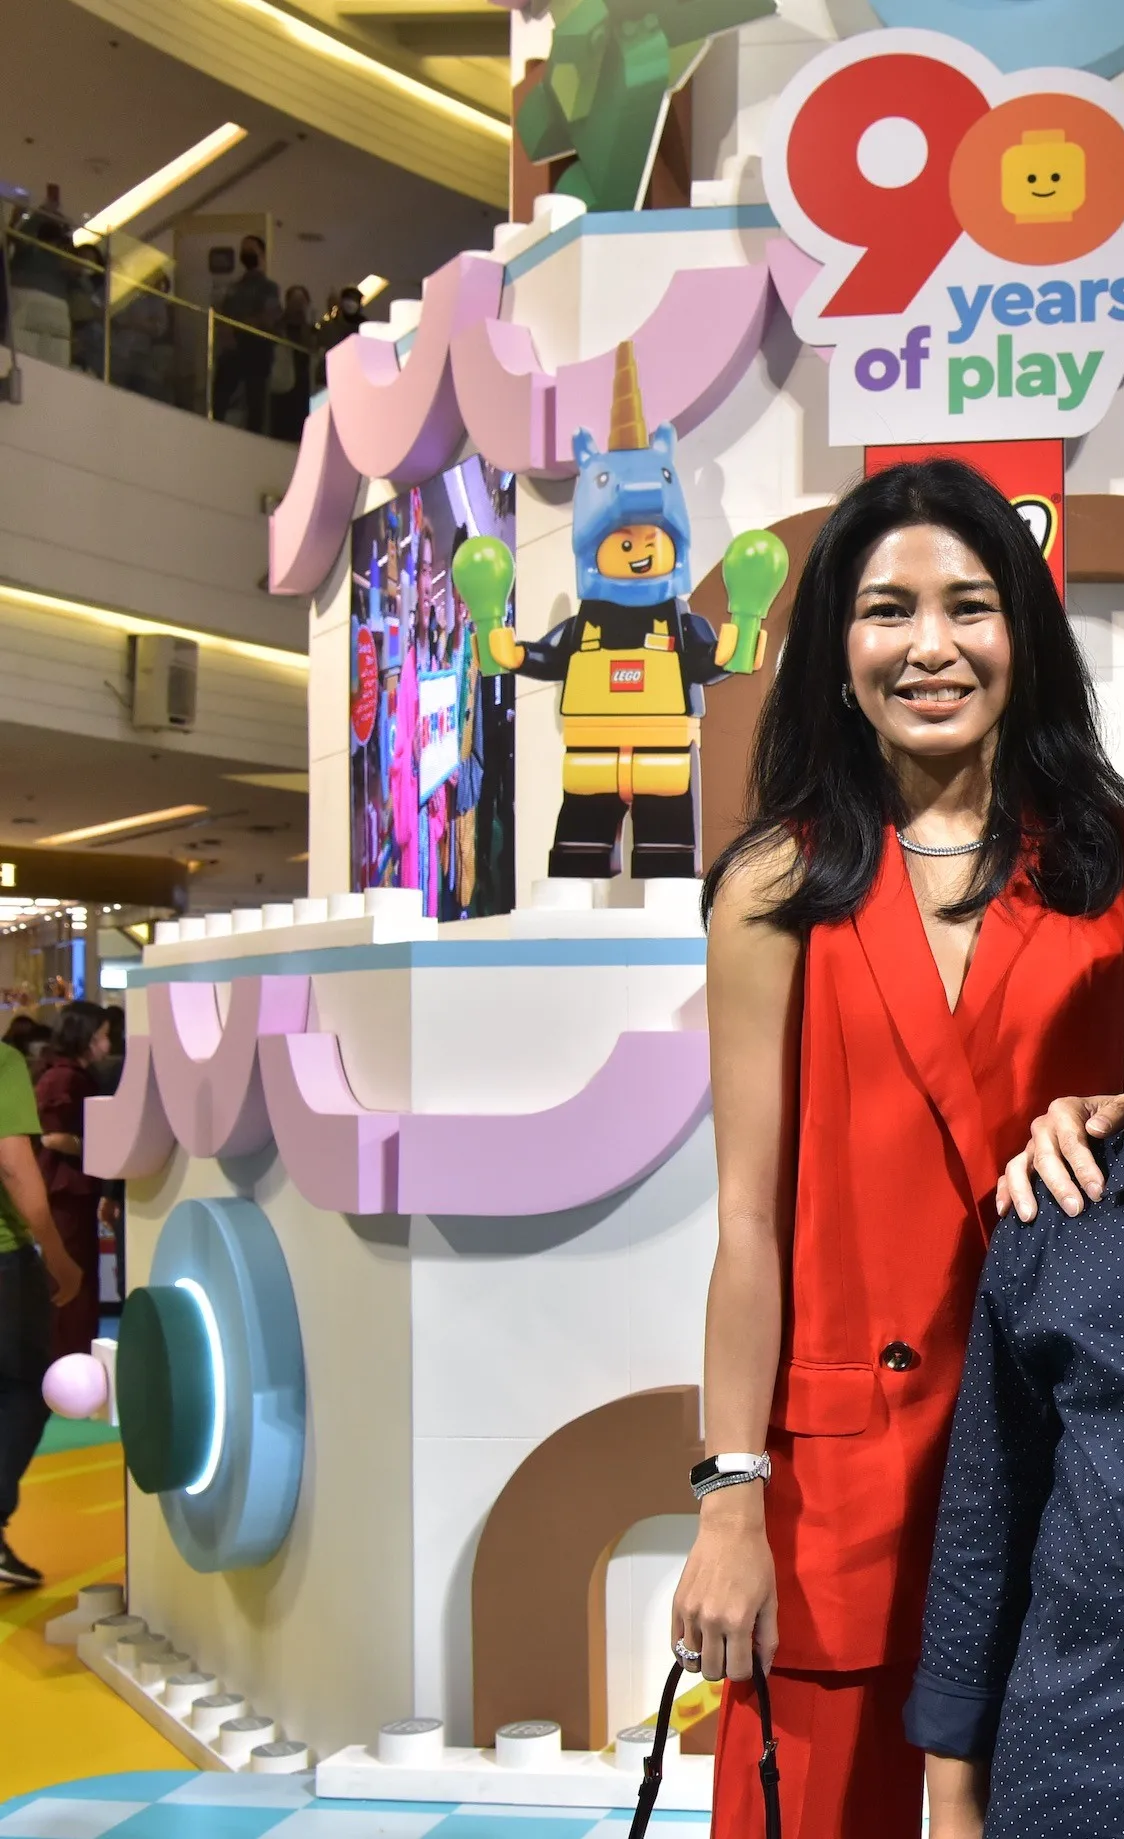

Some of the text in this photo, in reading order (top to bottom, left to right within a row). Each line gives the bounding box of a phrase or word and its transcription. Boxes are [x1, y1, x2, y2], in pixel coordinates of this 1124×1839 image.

[854, 325, 1105, 415] of play
[613, 669, 642, 682] LEGO
